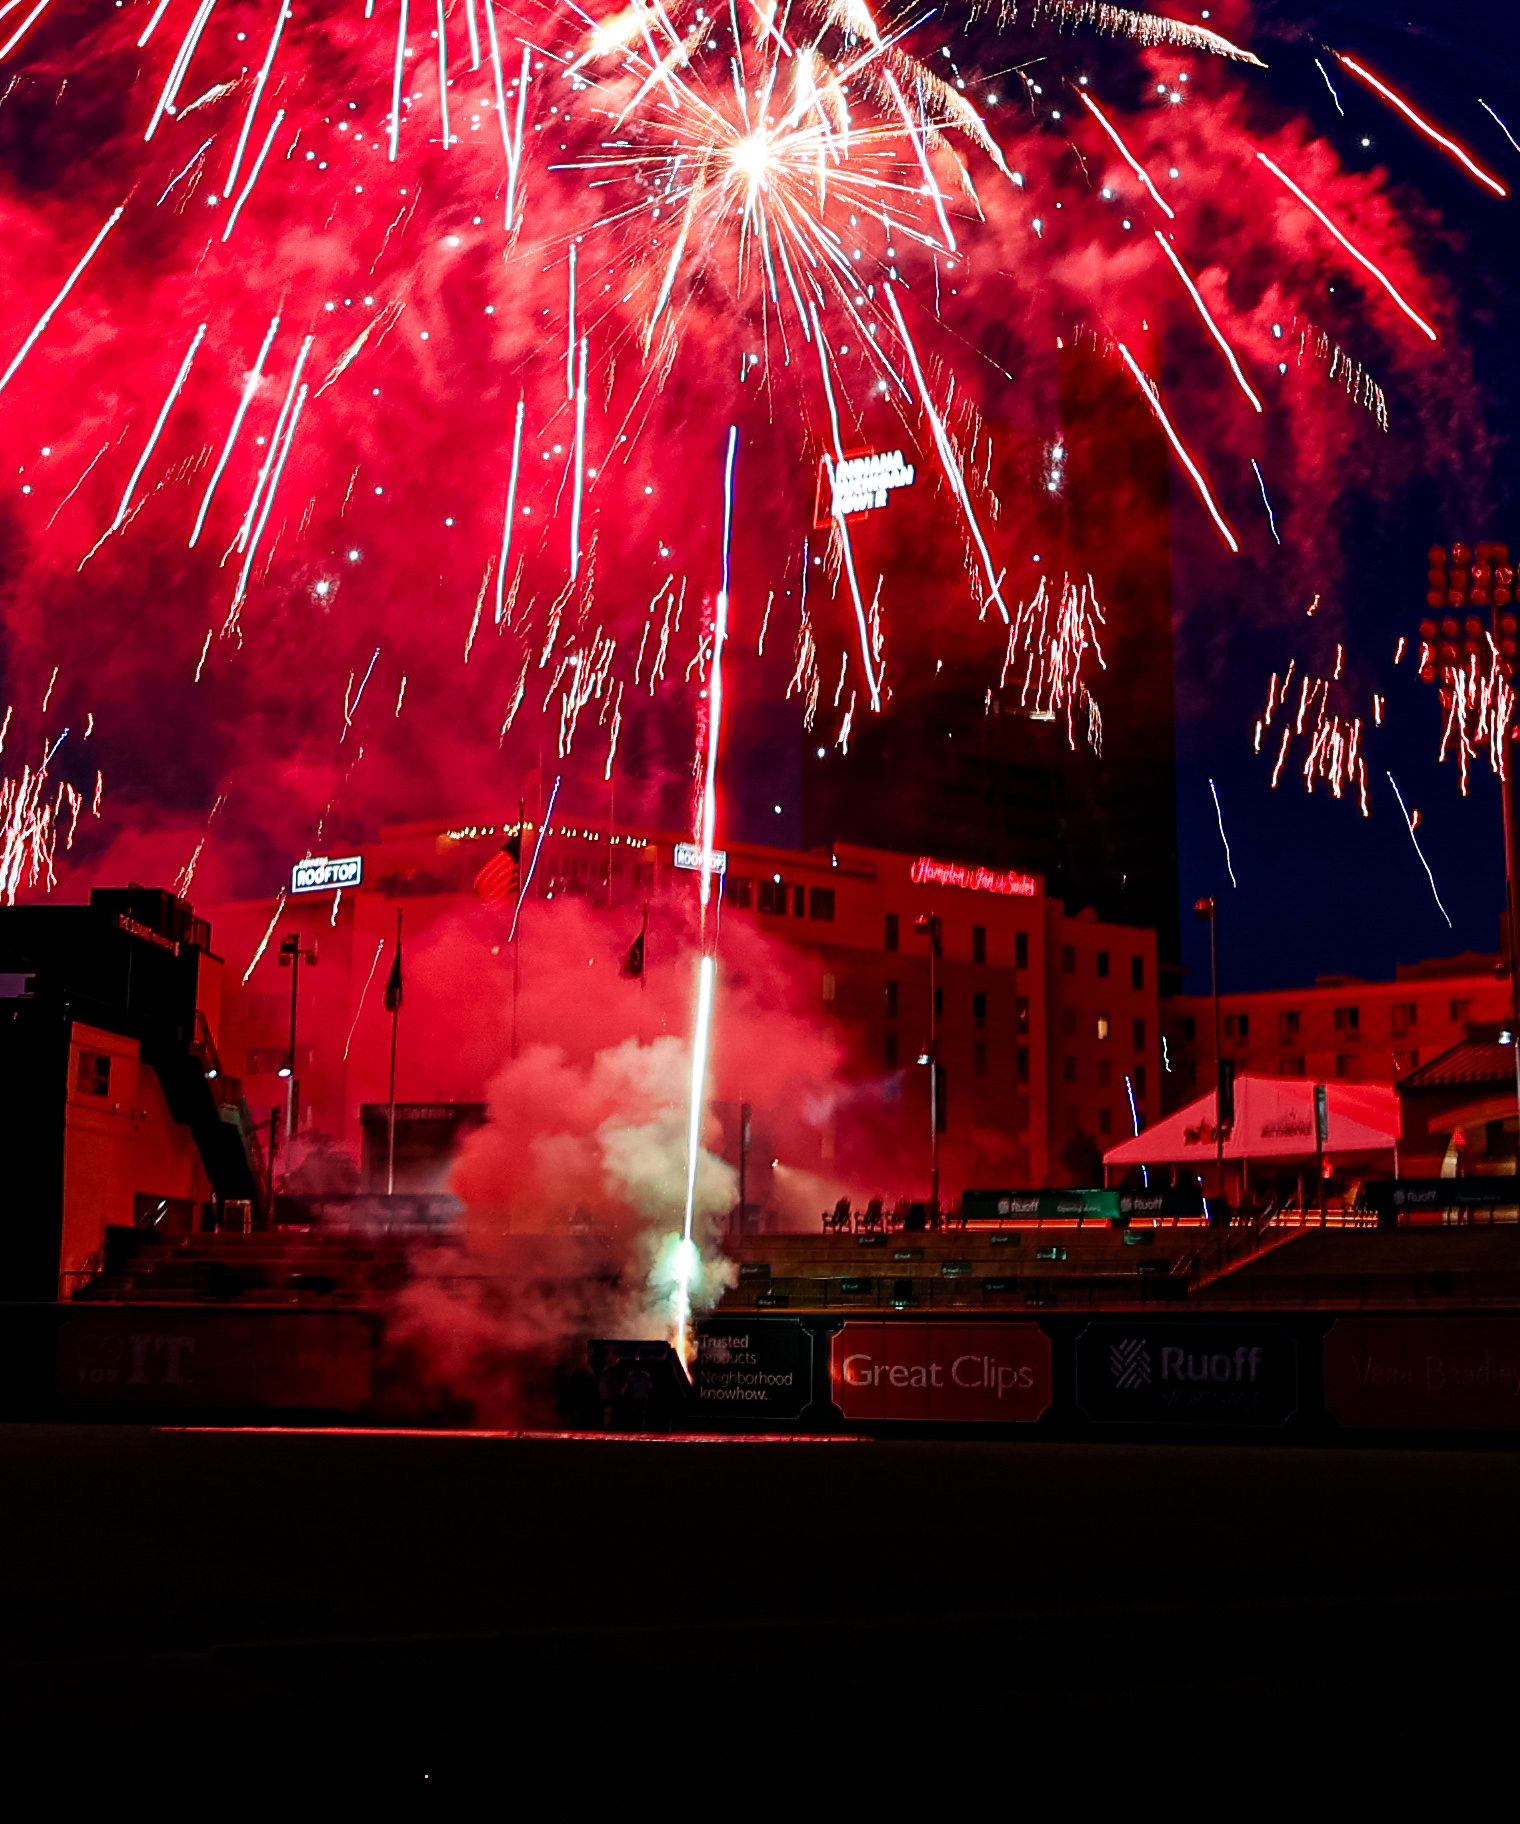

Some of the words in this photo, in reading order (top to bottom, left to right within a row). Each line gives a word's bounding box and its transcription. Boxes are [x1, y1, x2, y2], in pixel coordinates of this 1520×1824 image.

[297, 862, 357, 887] ROOFTOP
[700, 1334, 749, 1349] Trusted
[842, 1353, 945, 1388] Great
[951, 1353, 1036, 1399] Clips
[1160, 1345, 1263, 1382] Ruoff
